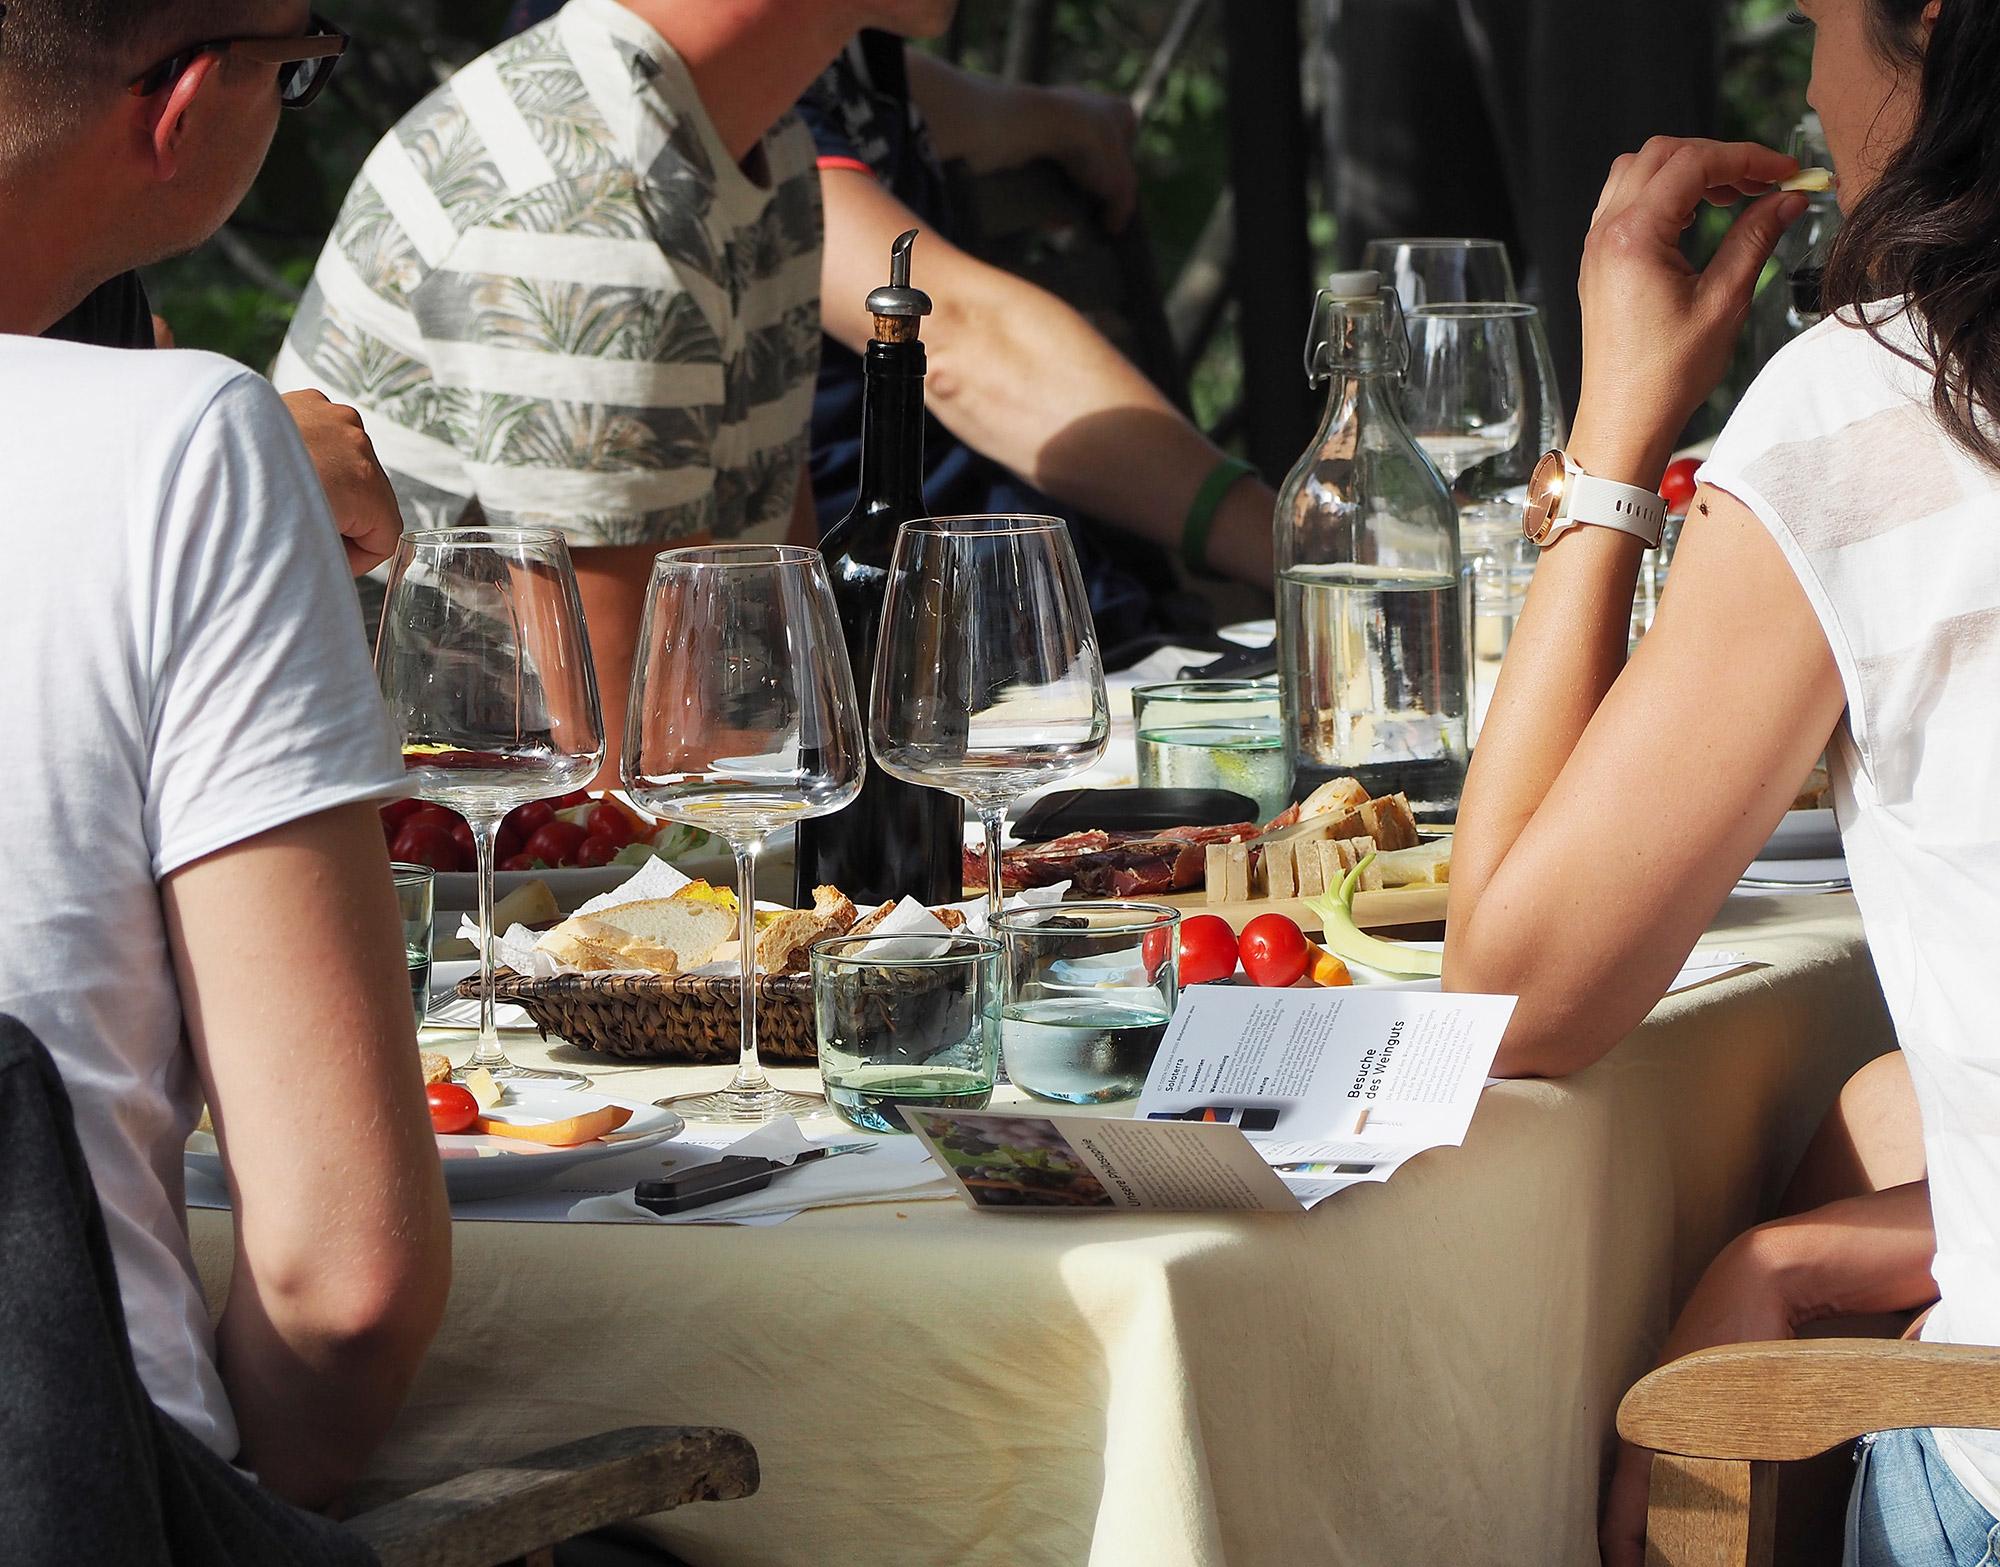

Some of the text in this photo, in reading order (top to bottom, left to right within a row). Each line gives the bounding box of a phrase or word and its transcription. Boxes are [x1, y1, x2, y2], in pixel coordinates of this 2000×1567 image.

[1165, 1058, 1184, 1092] Soloterra
[1347, 1048, 1376, 1099] Besuche
[1364, 1020, 1405, 1100] des Weinguts
[1081, 1138, 1141, 1207] Unsere Philosophie
